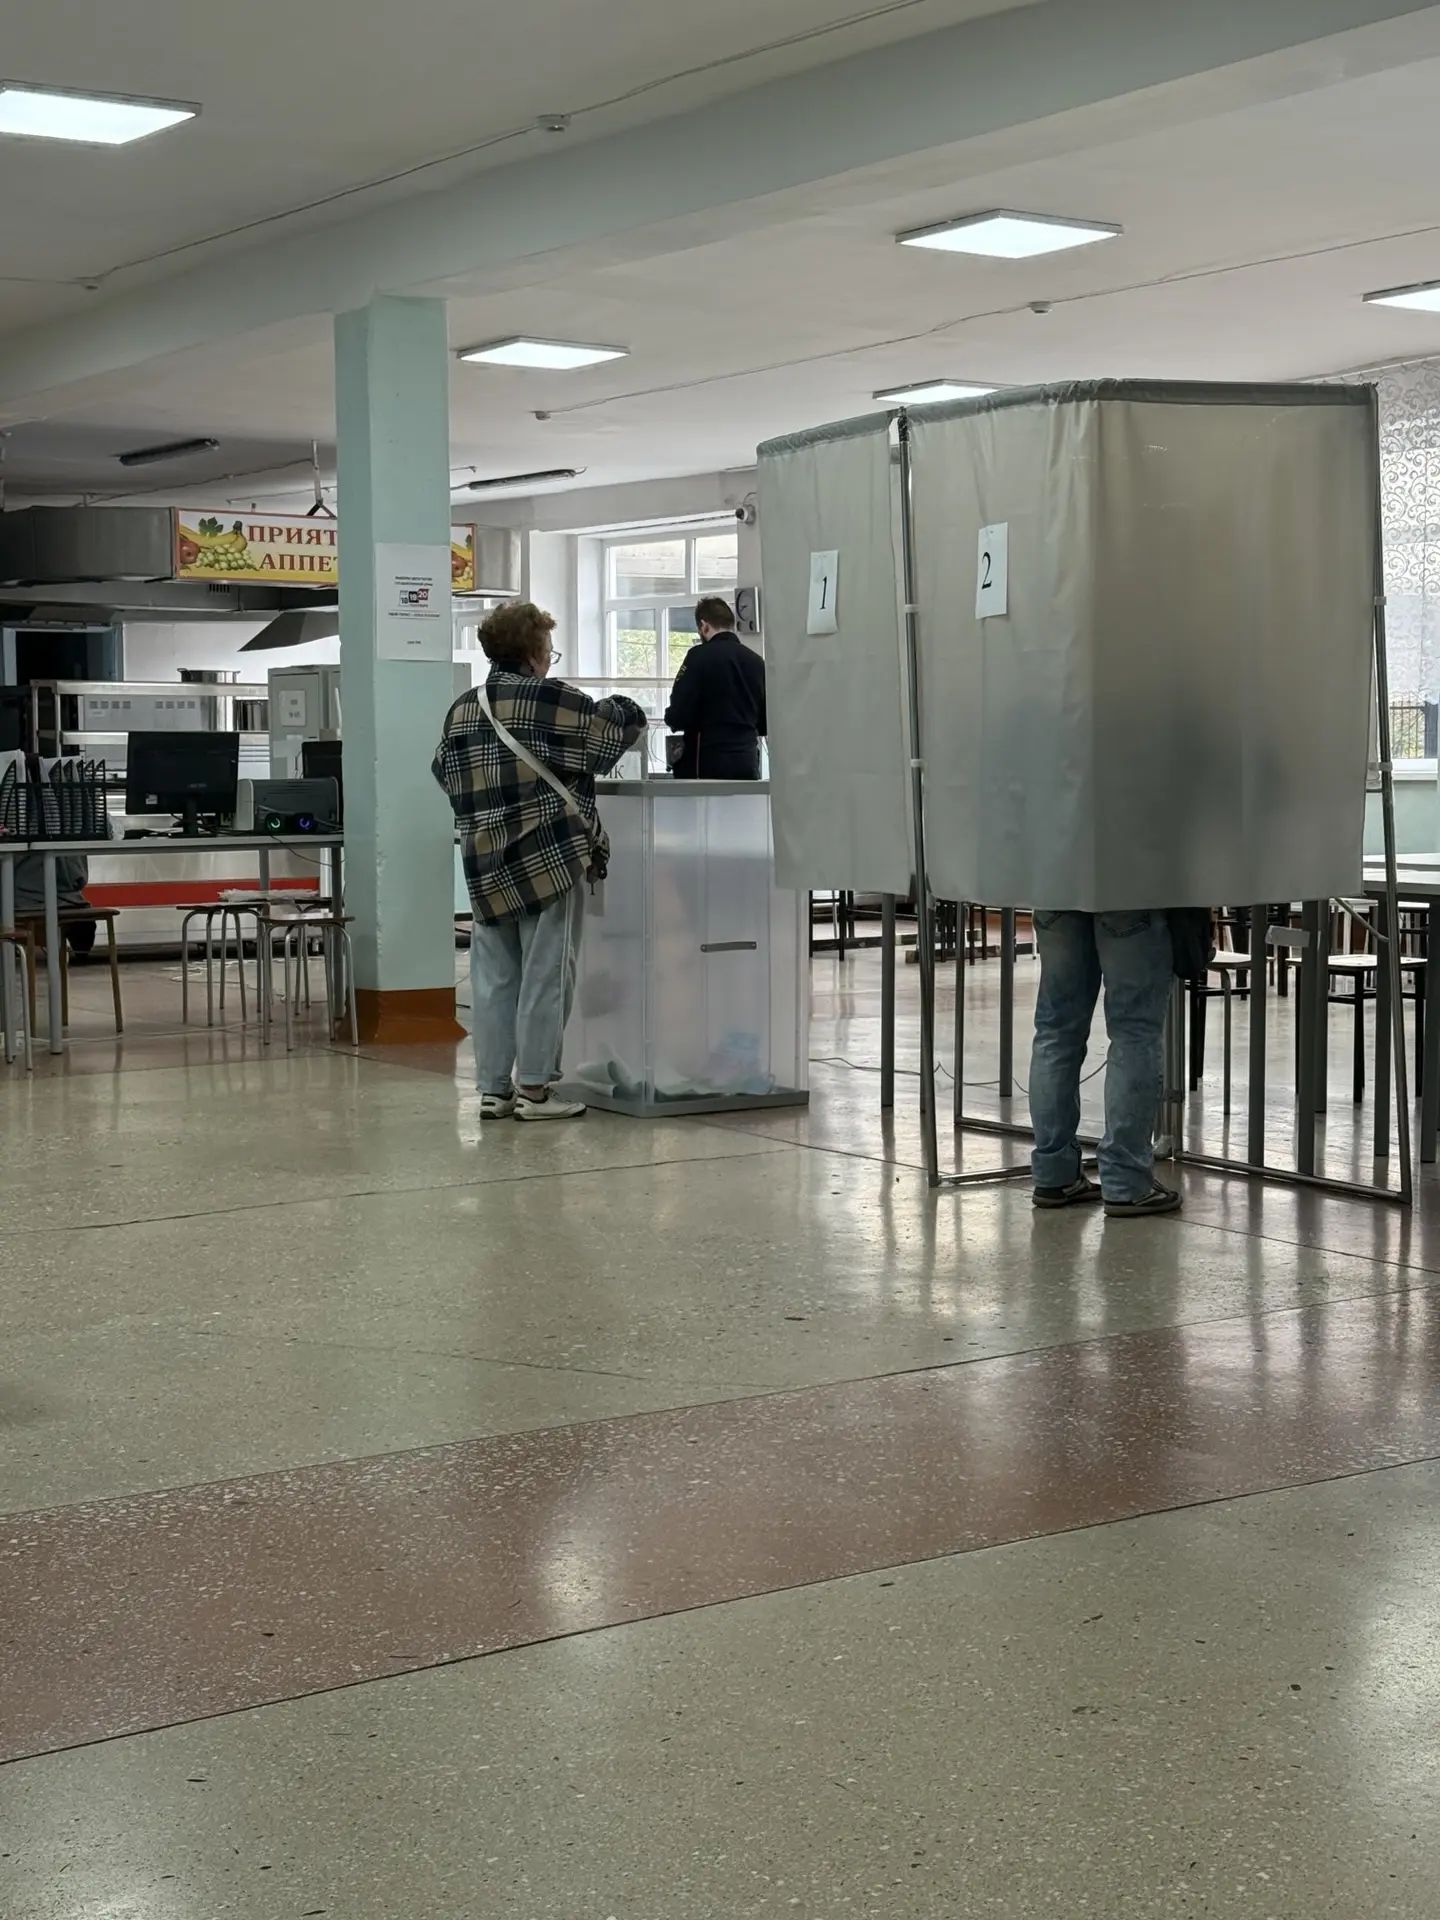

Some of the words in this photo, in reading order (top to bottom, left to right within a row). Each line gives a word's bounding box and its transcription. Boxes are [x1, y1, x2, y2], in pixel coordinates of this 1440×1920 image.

[259, 553, 337, 572] АППЕ
[981, 551, 993, 590] 2
[417, 590, 428, 600] 20
[819, 575, 828, 610] 1
